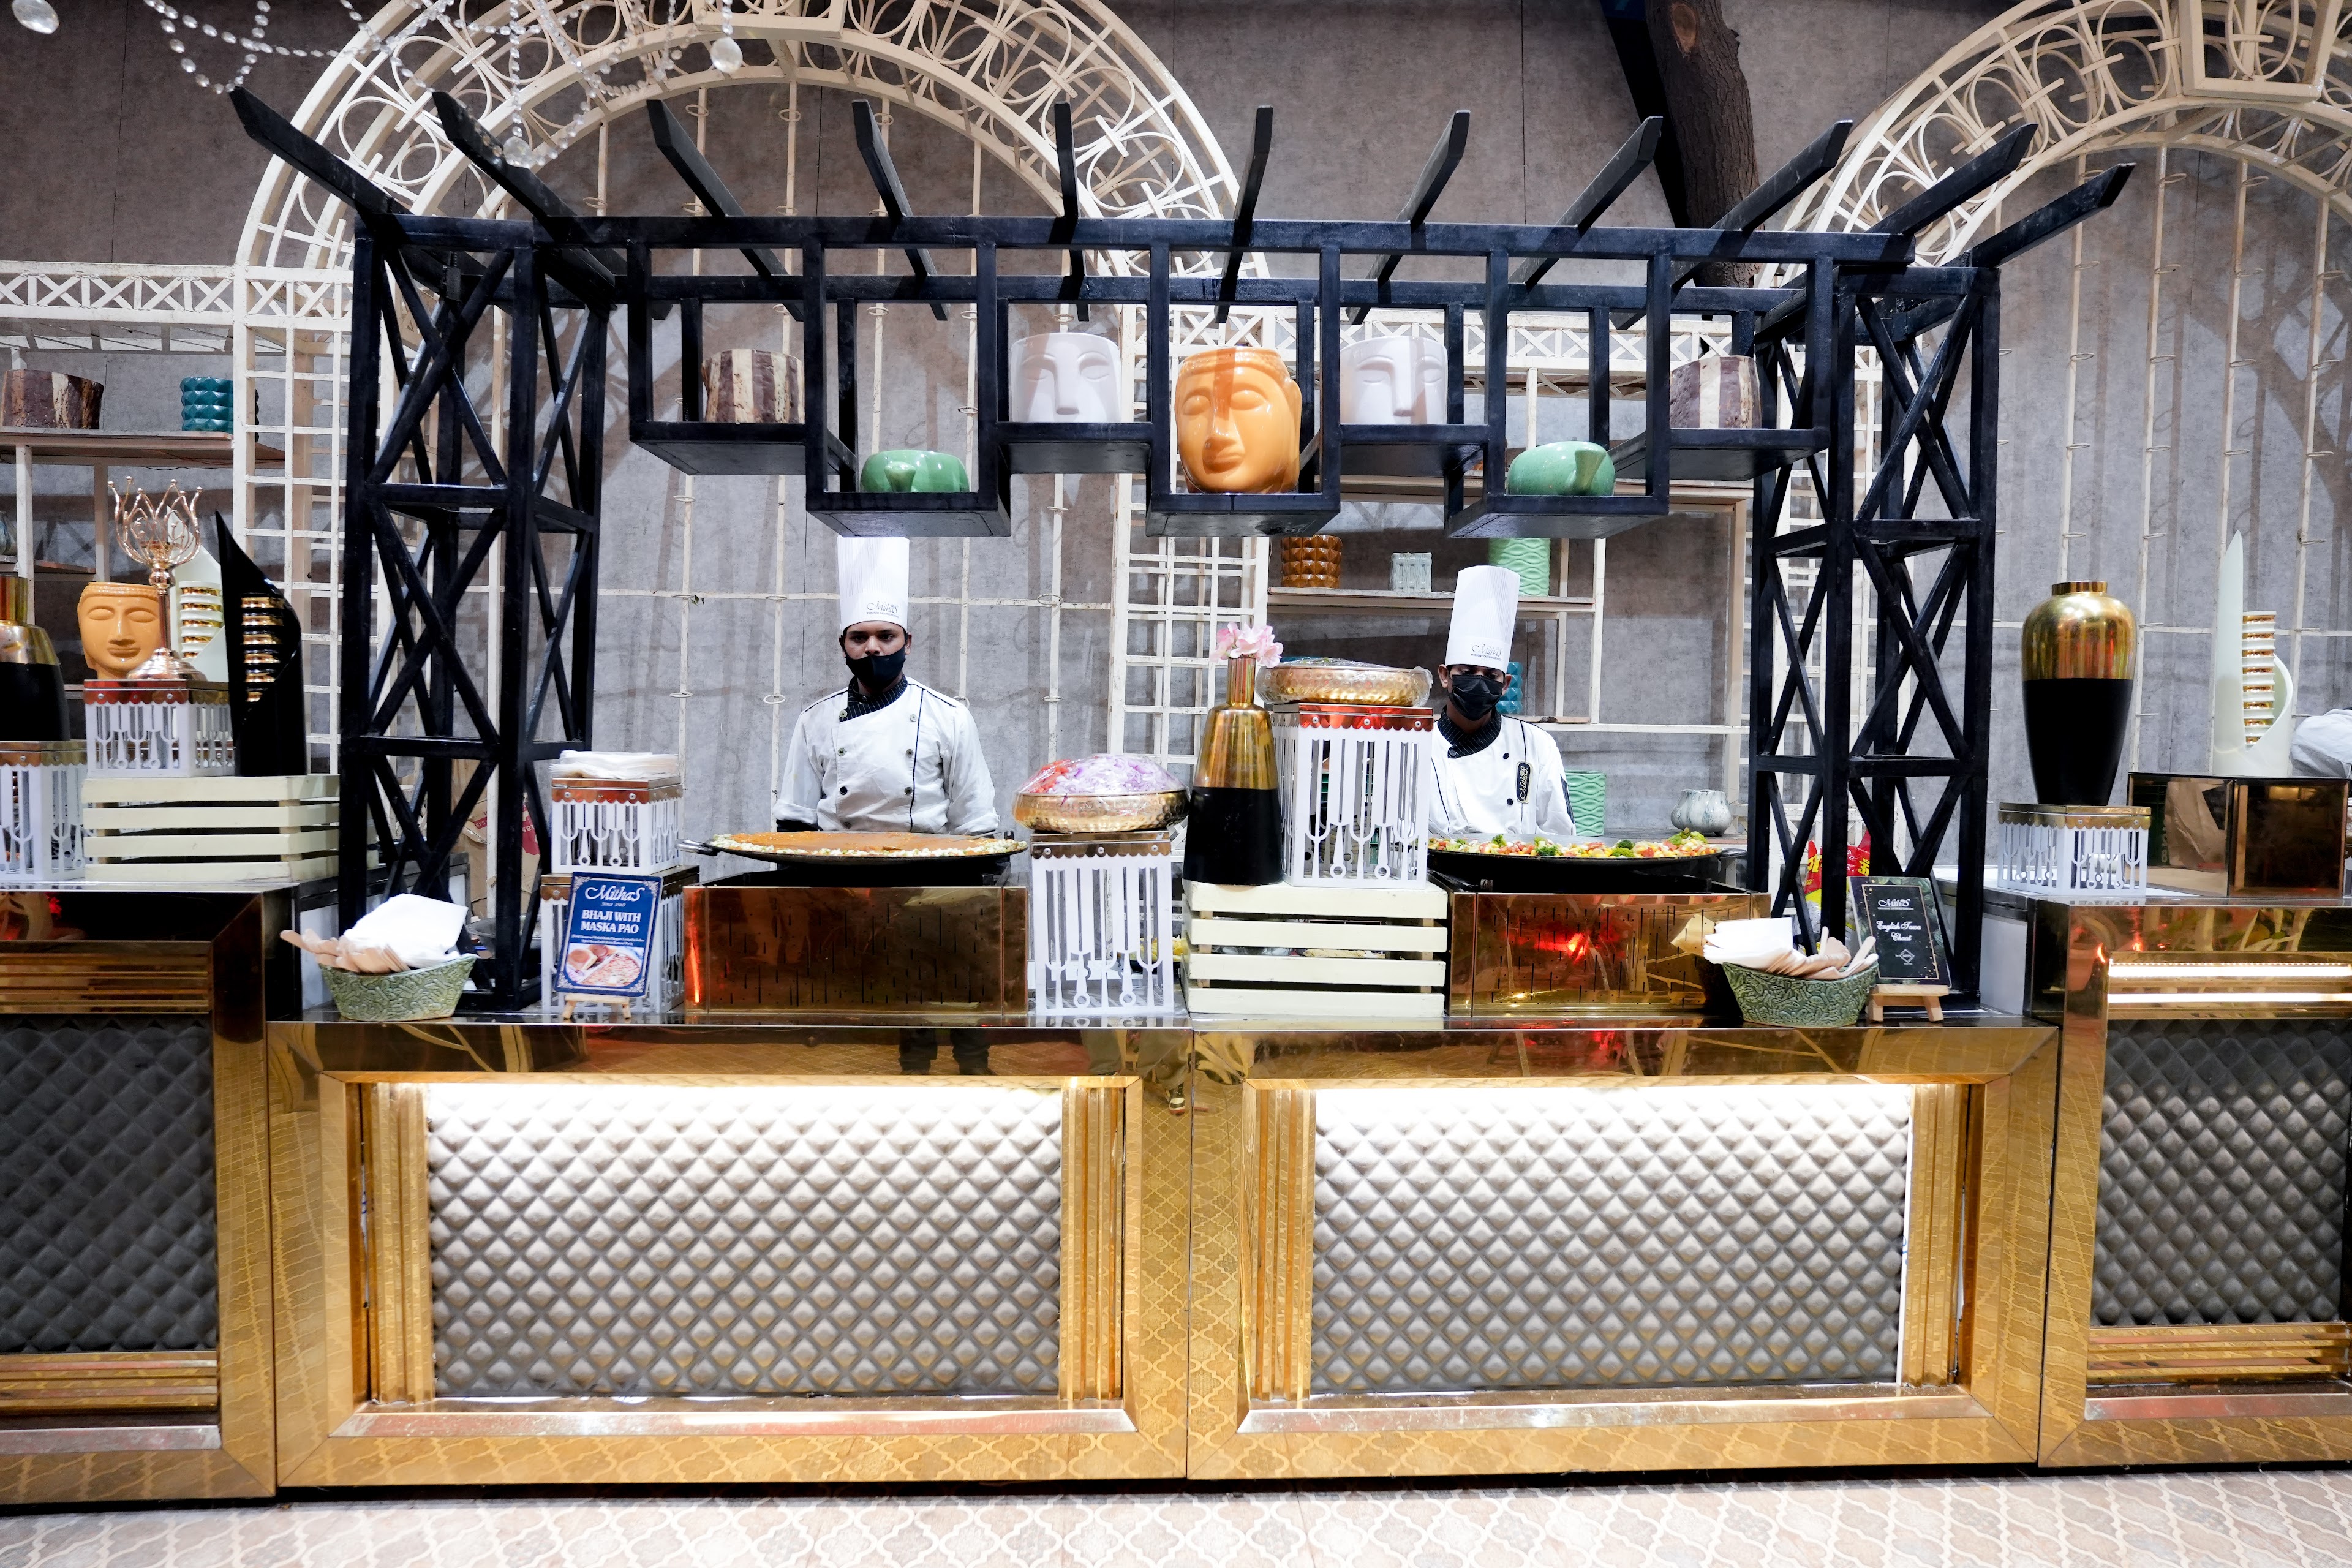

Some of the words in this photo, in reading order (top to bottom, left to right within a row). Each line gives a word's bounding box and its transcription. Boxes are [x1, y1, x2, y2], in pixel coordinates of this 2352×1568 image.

[581, 910, 613, 921] BHAJI
[614, 911, 641, 922] WITH
[581, 921, 617, 932] MASKA
[618, 923, 639, 933] PAO
[1876, 921, 1900, 932] English
[1901, 921, 1921, 930] Tawa
[1891, 932, 1912, 941] Chaat
